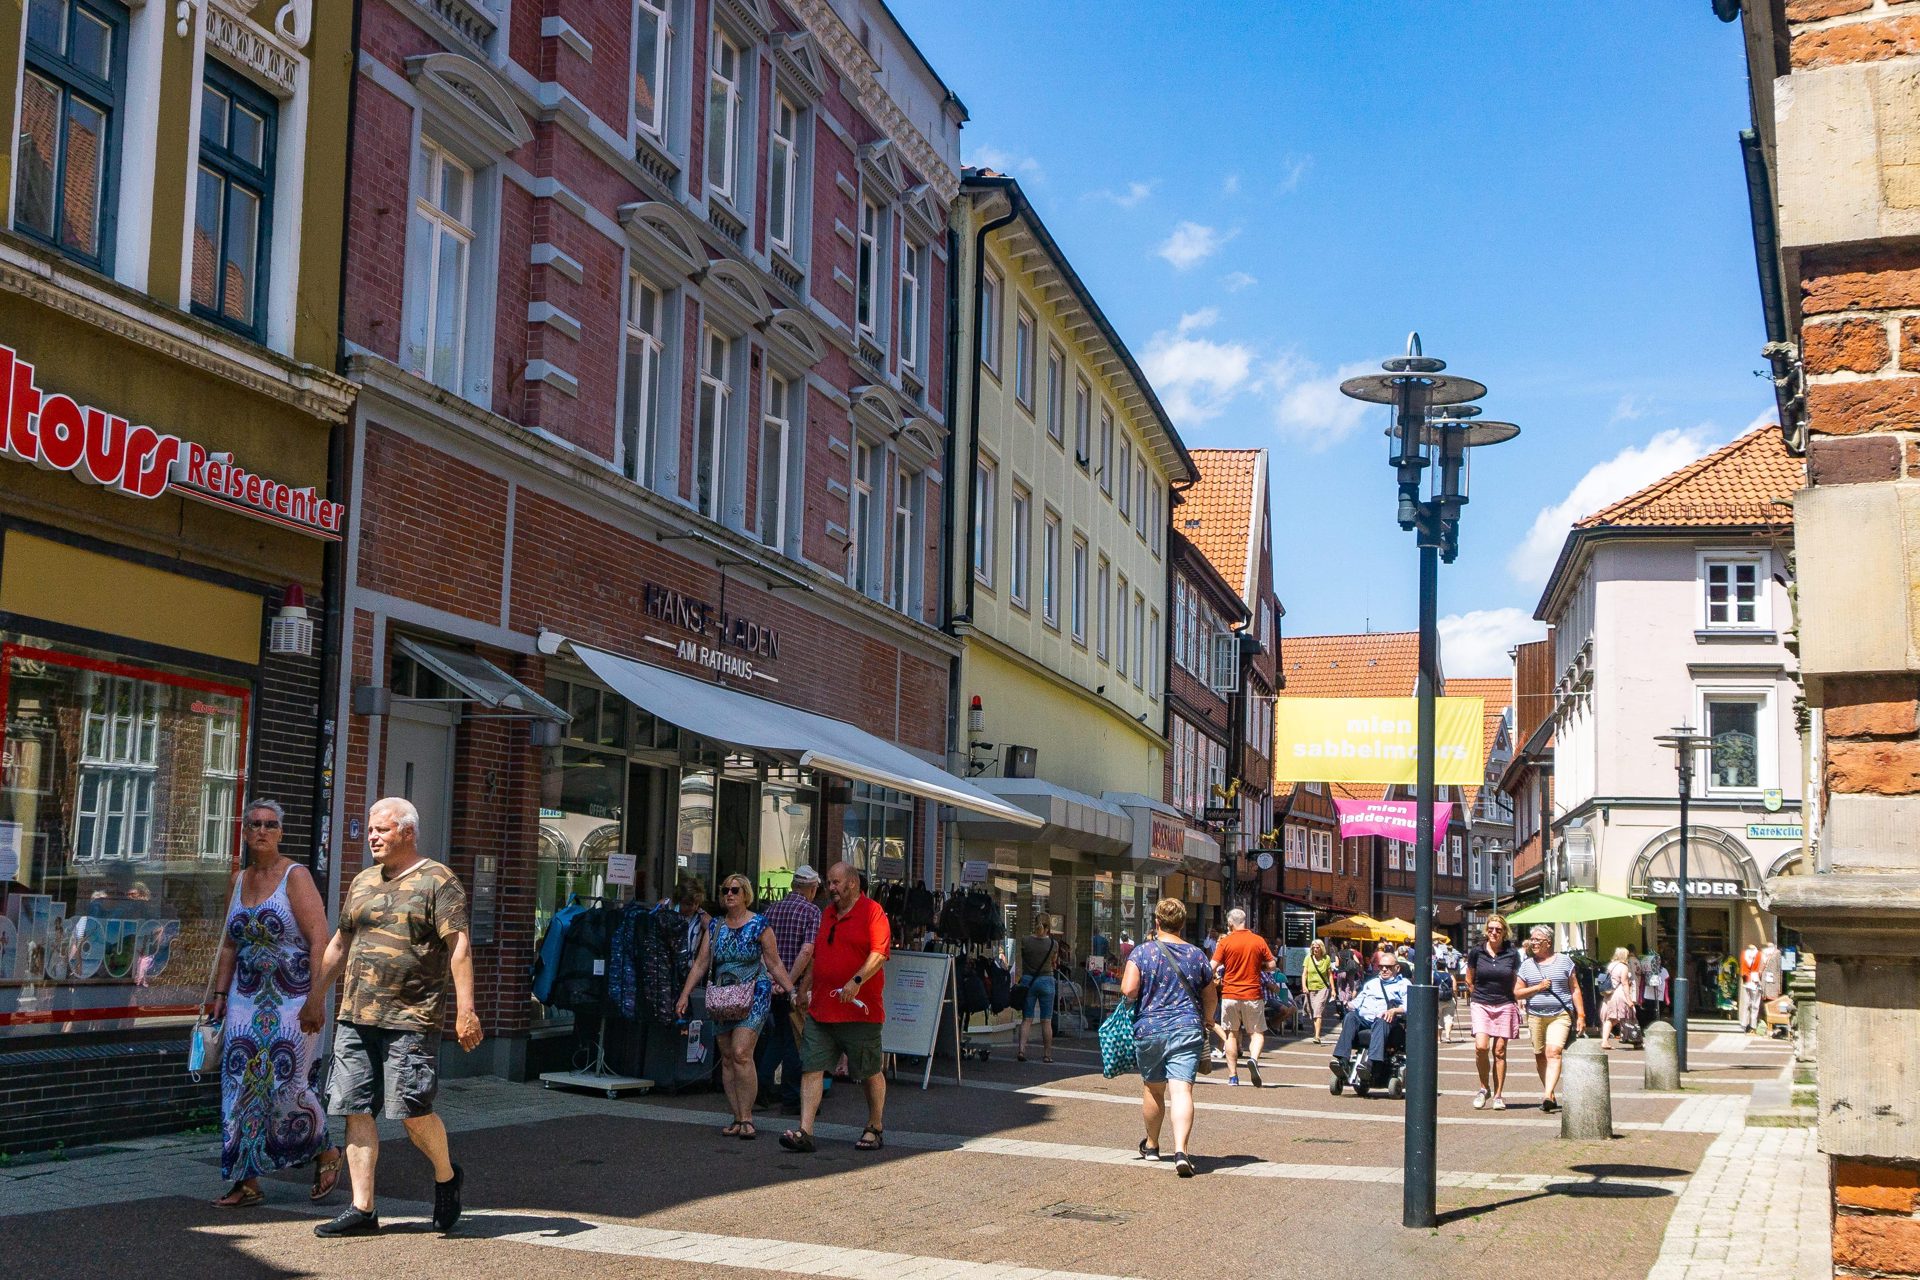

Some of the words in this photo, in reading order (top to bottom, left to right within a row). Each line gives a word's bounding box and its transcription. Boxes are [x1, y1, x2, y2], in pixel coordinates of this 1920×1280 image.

[187, 442, 344, 531] Reisecenter
[677, 639, 697, 663] AM
[700, 647, 753, 680] RATHAUS
[1347, 716, 1412, 734] mien
[1367, 804, 1407, 814] mien
[1652, 880, 1738, 895] SANDER
